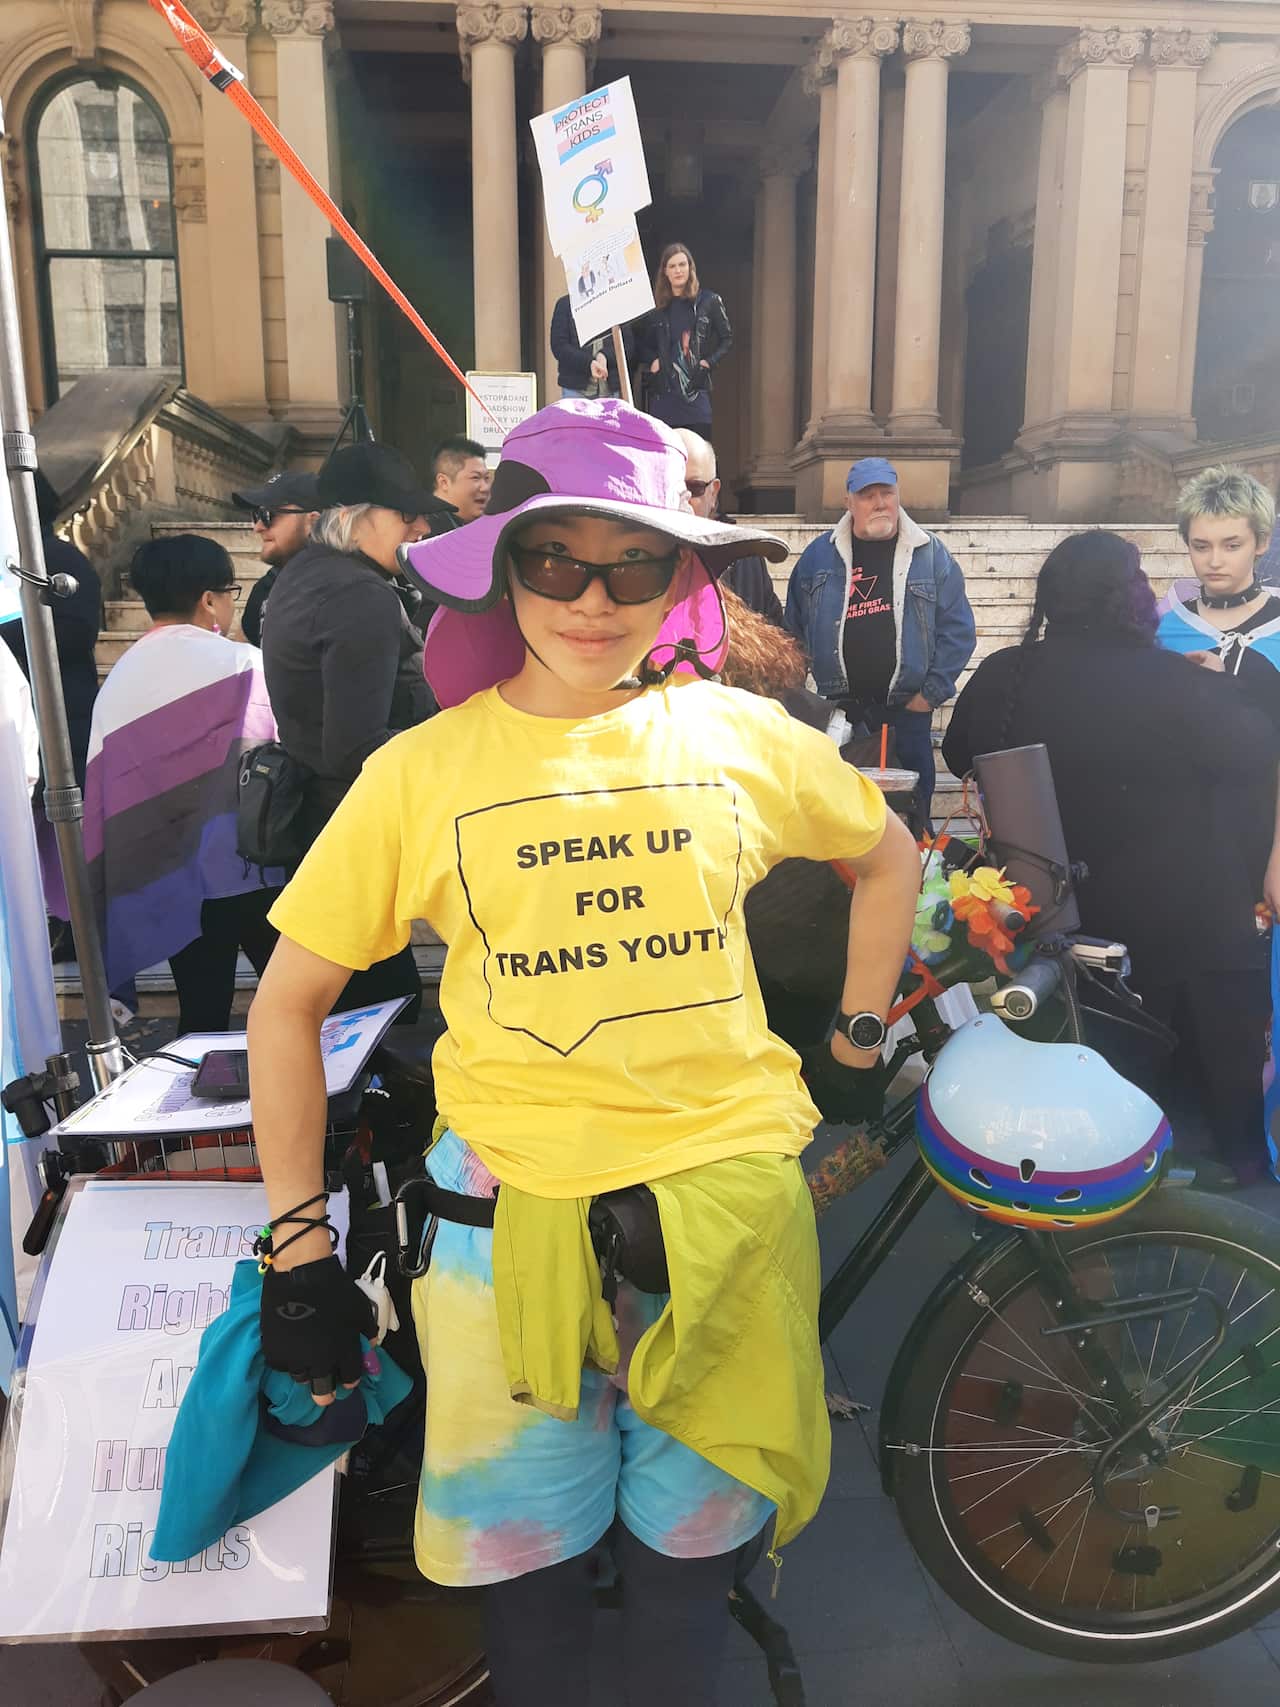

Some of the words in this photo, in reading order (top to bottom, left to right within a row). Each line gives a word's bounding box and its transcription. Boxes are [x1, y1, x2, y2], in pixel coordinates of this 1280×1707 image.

[554, 95, 609, 133] PROTECT
[564, 110, 603, 139] TRANS
[569, 125, 601, 149] KIDS
[847, 609, 866, 618] ARDI
[868, 604, 890, 614] GRAS
[859, 598, 883, 610] FIRST
[516, 833, 635, 869] SPEAK
[646, 827, 693, 855] UP
[575, 885, 646, 916] FOR
[496, 943, 608, 977] TRANS
[117, 1283, 231, 1335] Righ
